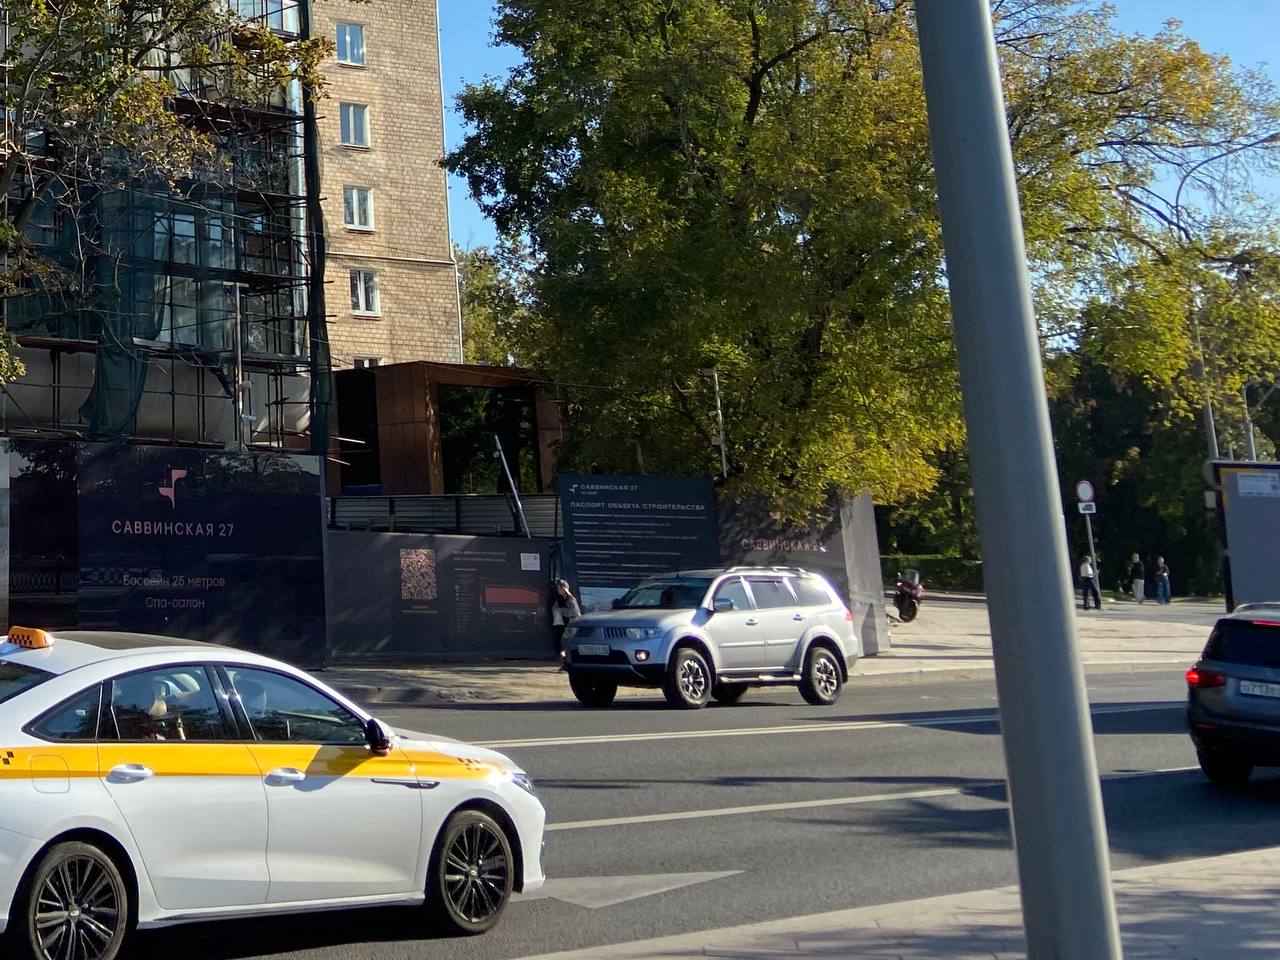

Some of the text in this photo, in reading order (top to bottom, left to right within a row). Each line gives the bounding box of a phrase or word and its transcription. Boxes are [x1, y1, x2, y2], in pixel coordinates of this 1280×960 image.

[570, 501, 605, 509] ПАСПОРТ
[642, 503, 705, 511] СТРОИТЕЛЬСТВА
[111, 519, 234, 537] САВВИНСКАЯ 27
[122, 574, 225, 590] Бассейн 25 метров
[145, 596, 206, 608] Спа-салон
